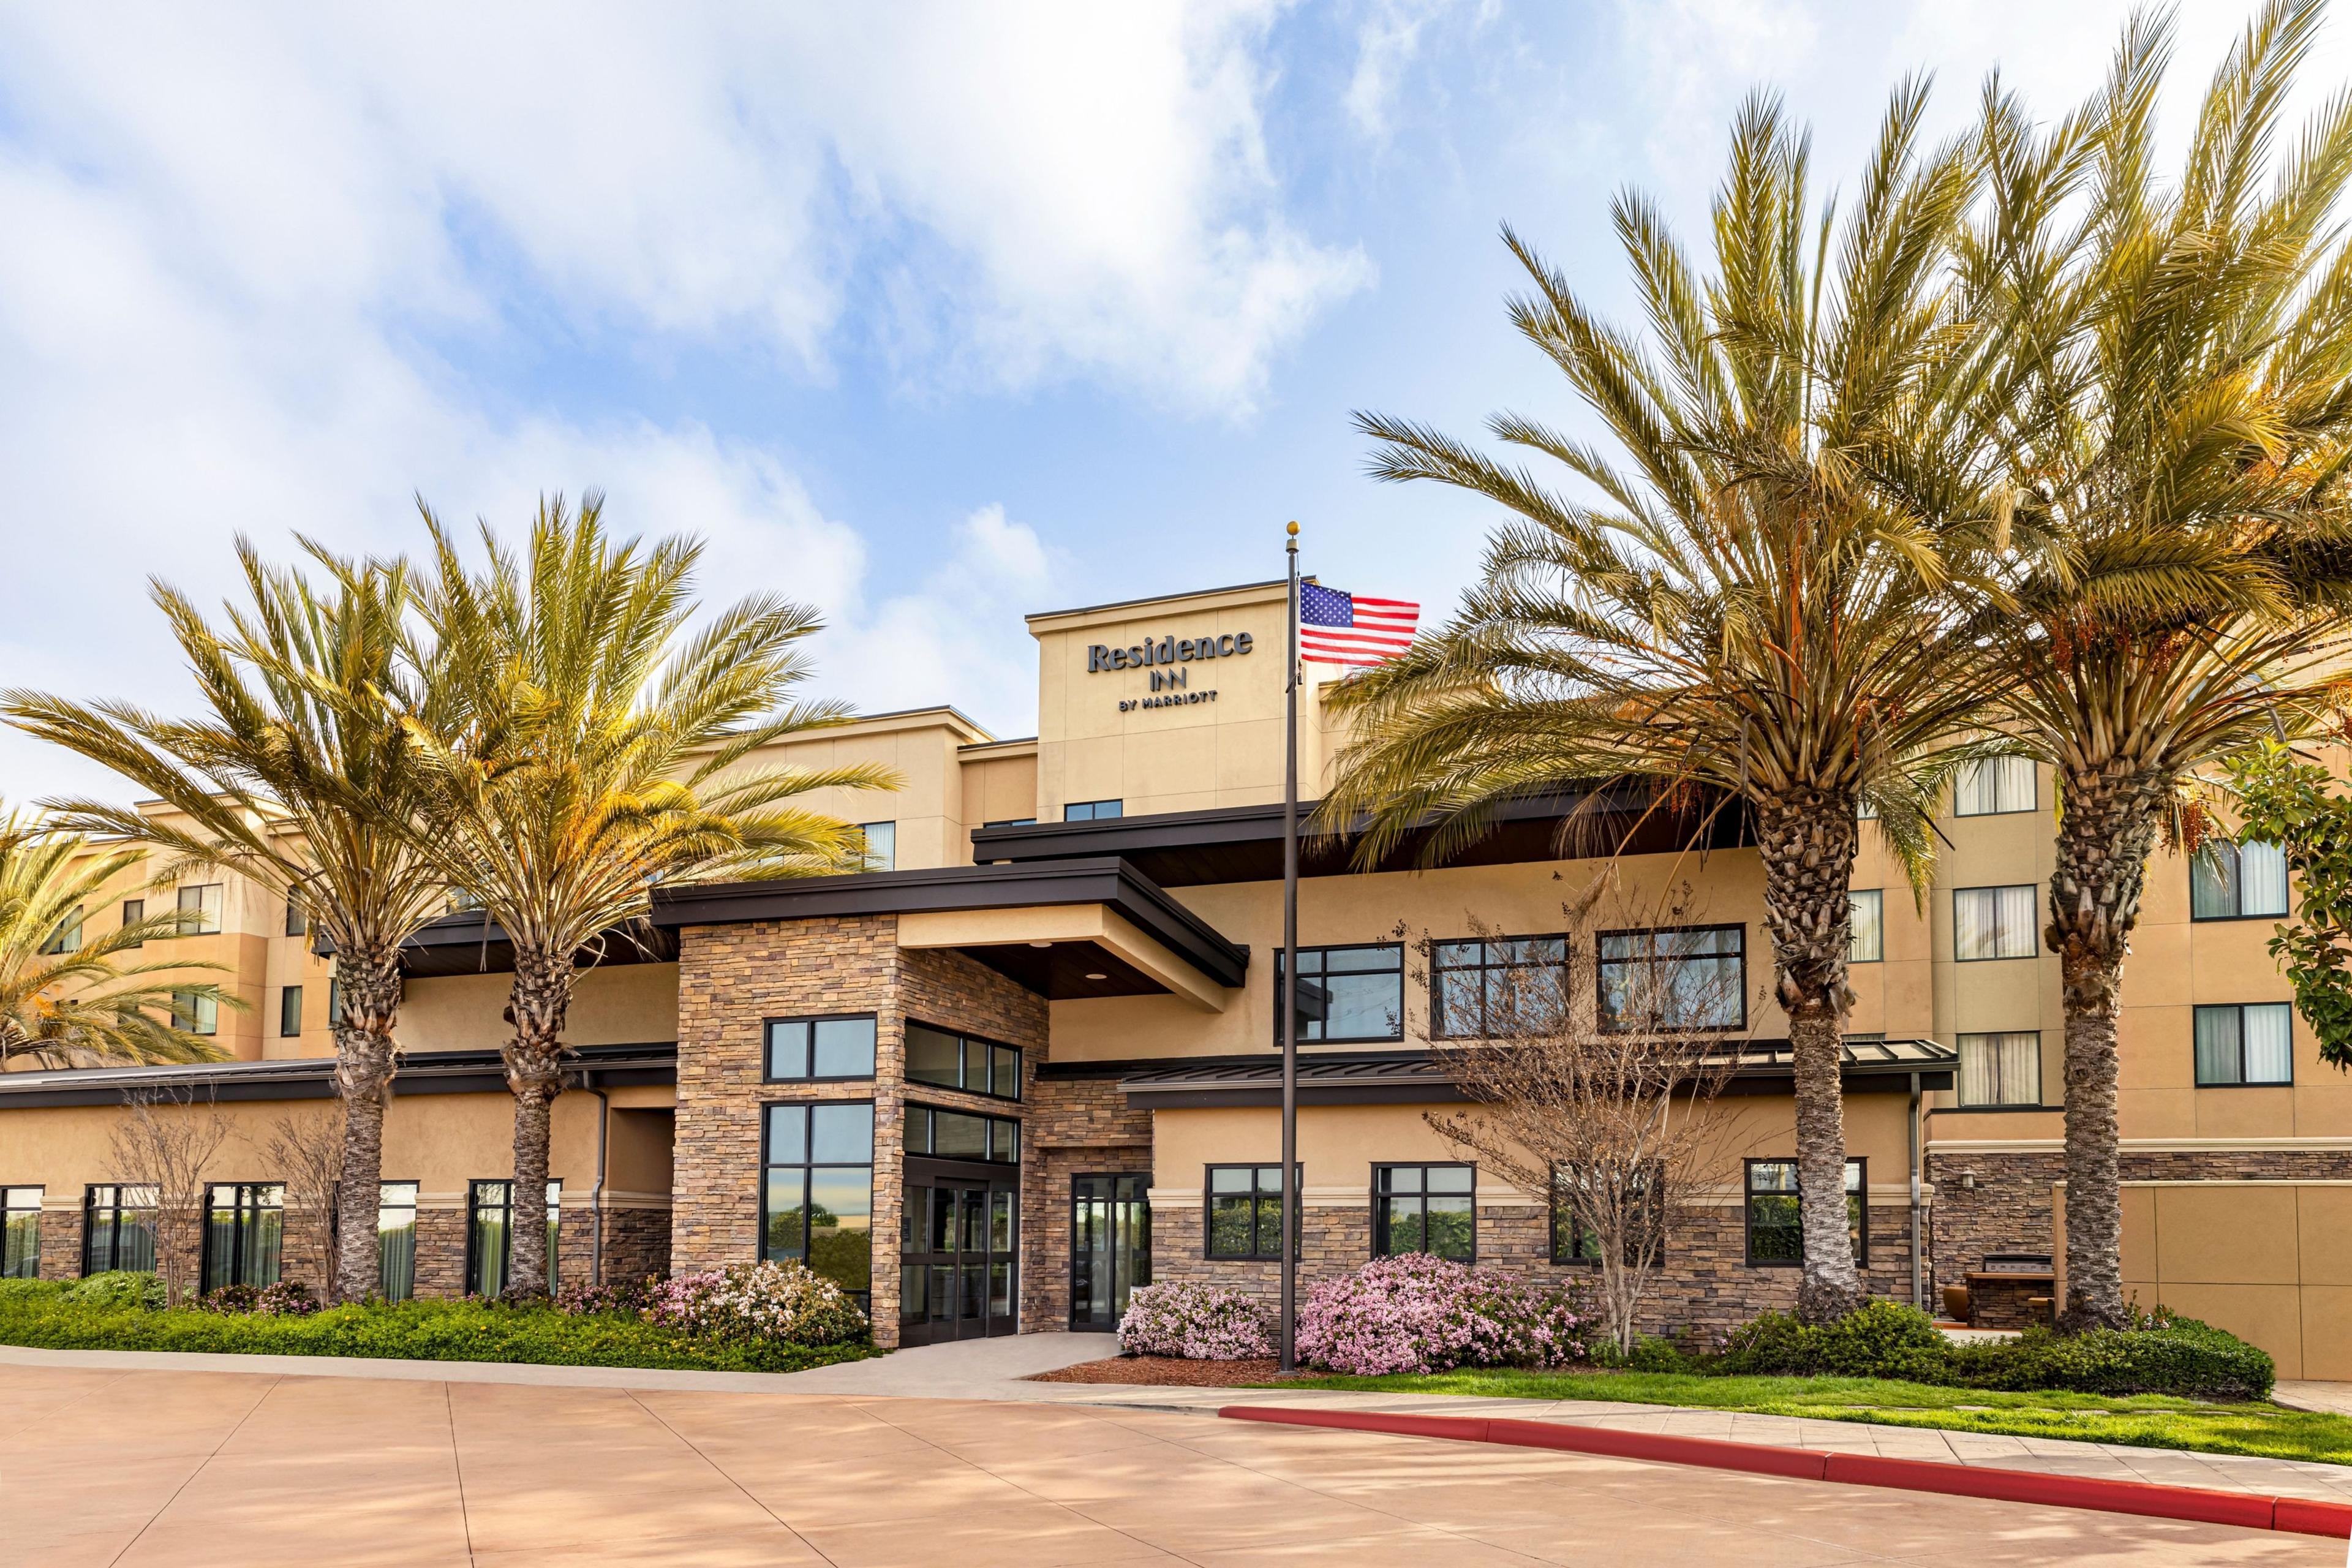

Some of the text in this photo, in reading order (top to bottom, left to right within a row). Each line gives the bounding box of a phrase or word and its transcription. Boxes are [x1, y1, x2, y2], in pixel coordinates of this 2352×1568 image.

[1087, 632, 1253, 673] Residence
[1150, 666, 1187, 692] INN
[1118, 690, 1218, 712] BY MARRIOTT
